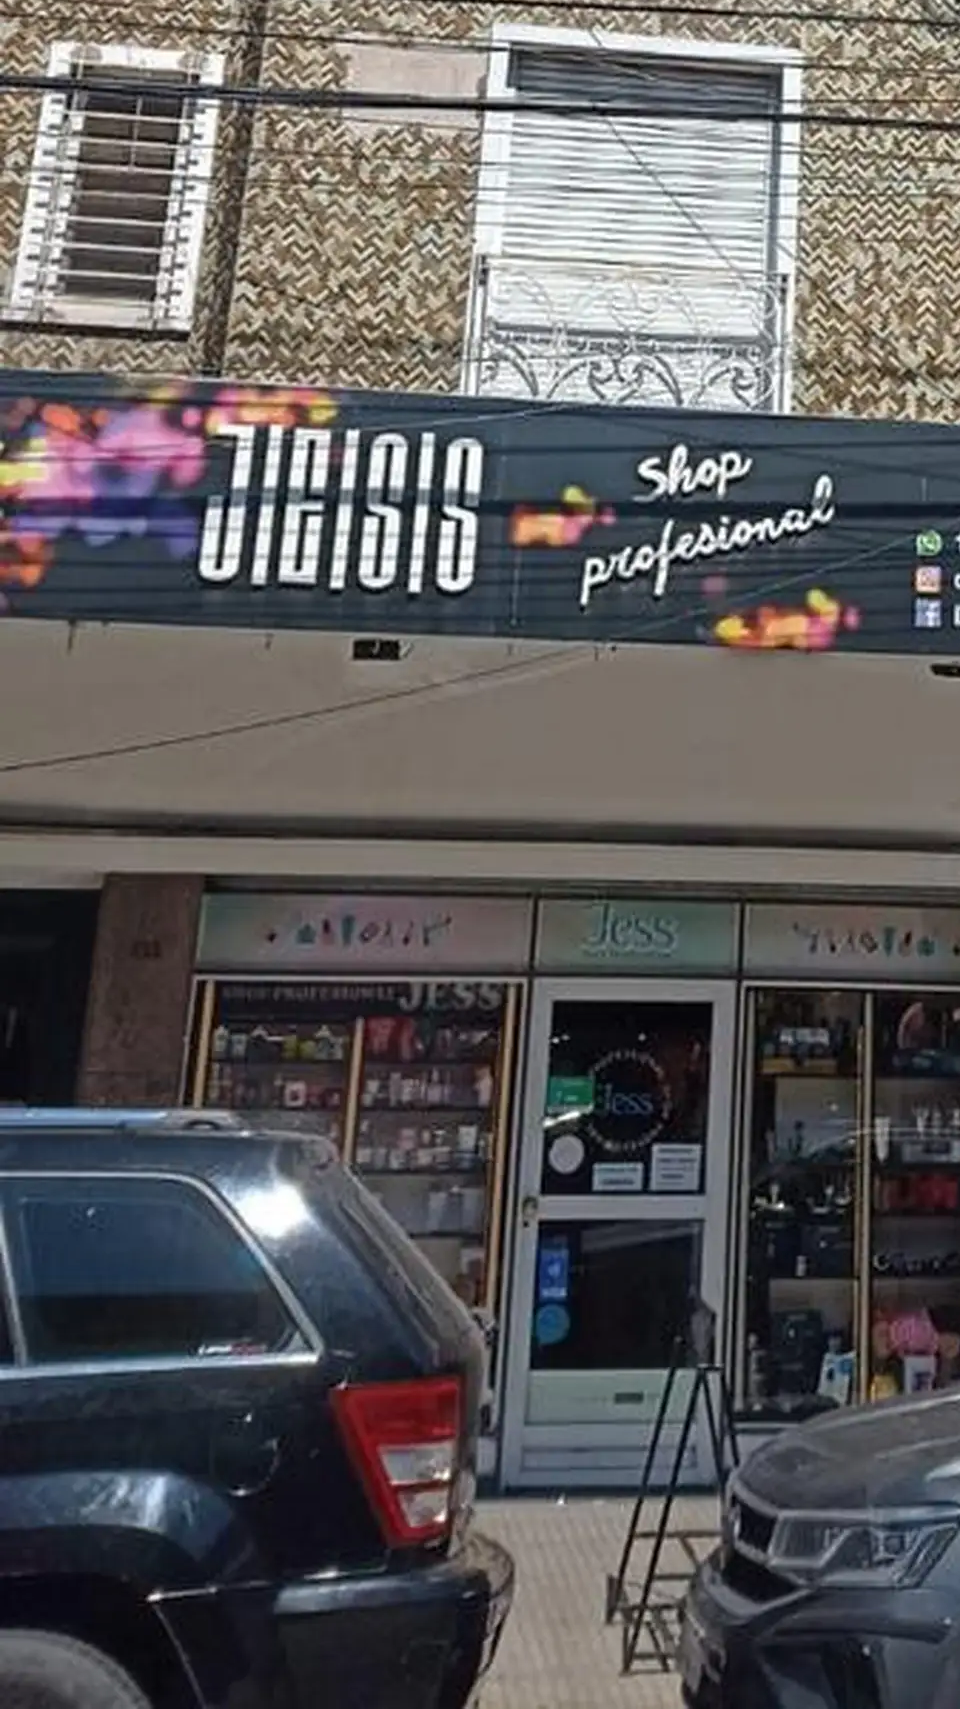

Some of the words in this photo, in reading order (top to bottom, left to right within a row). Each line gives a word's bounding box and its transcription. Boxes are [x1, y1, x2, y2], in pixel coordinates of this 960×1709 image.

[633, 444, 752, 502] Shop
[579, 474, 834, 607] profesional
[581, 903, 678, 950] Jess
